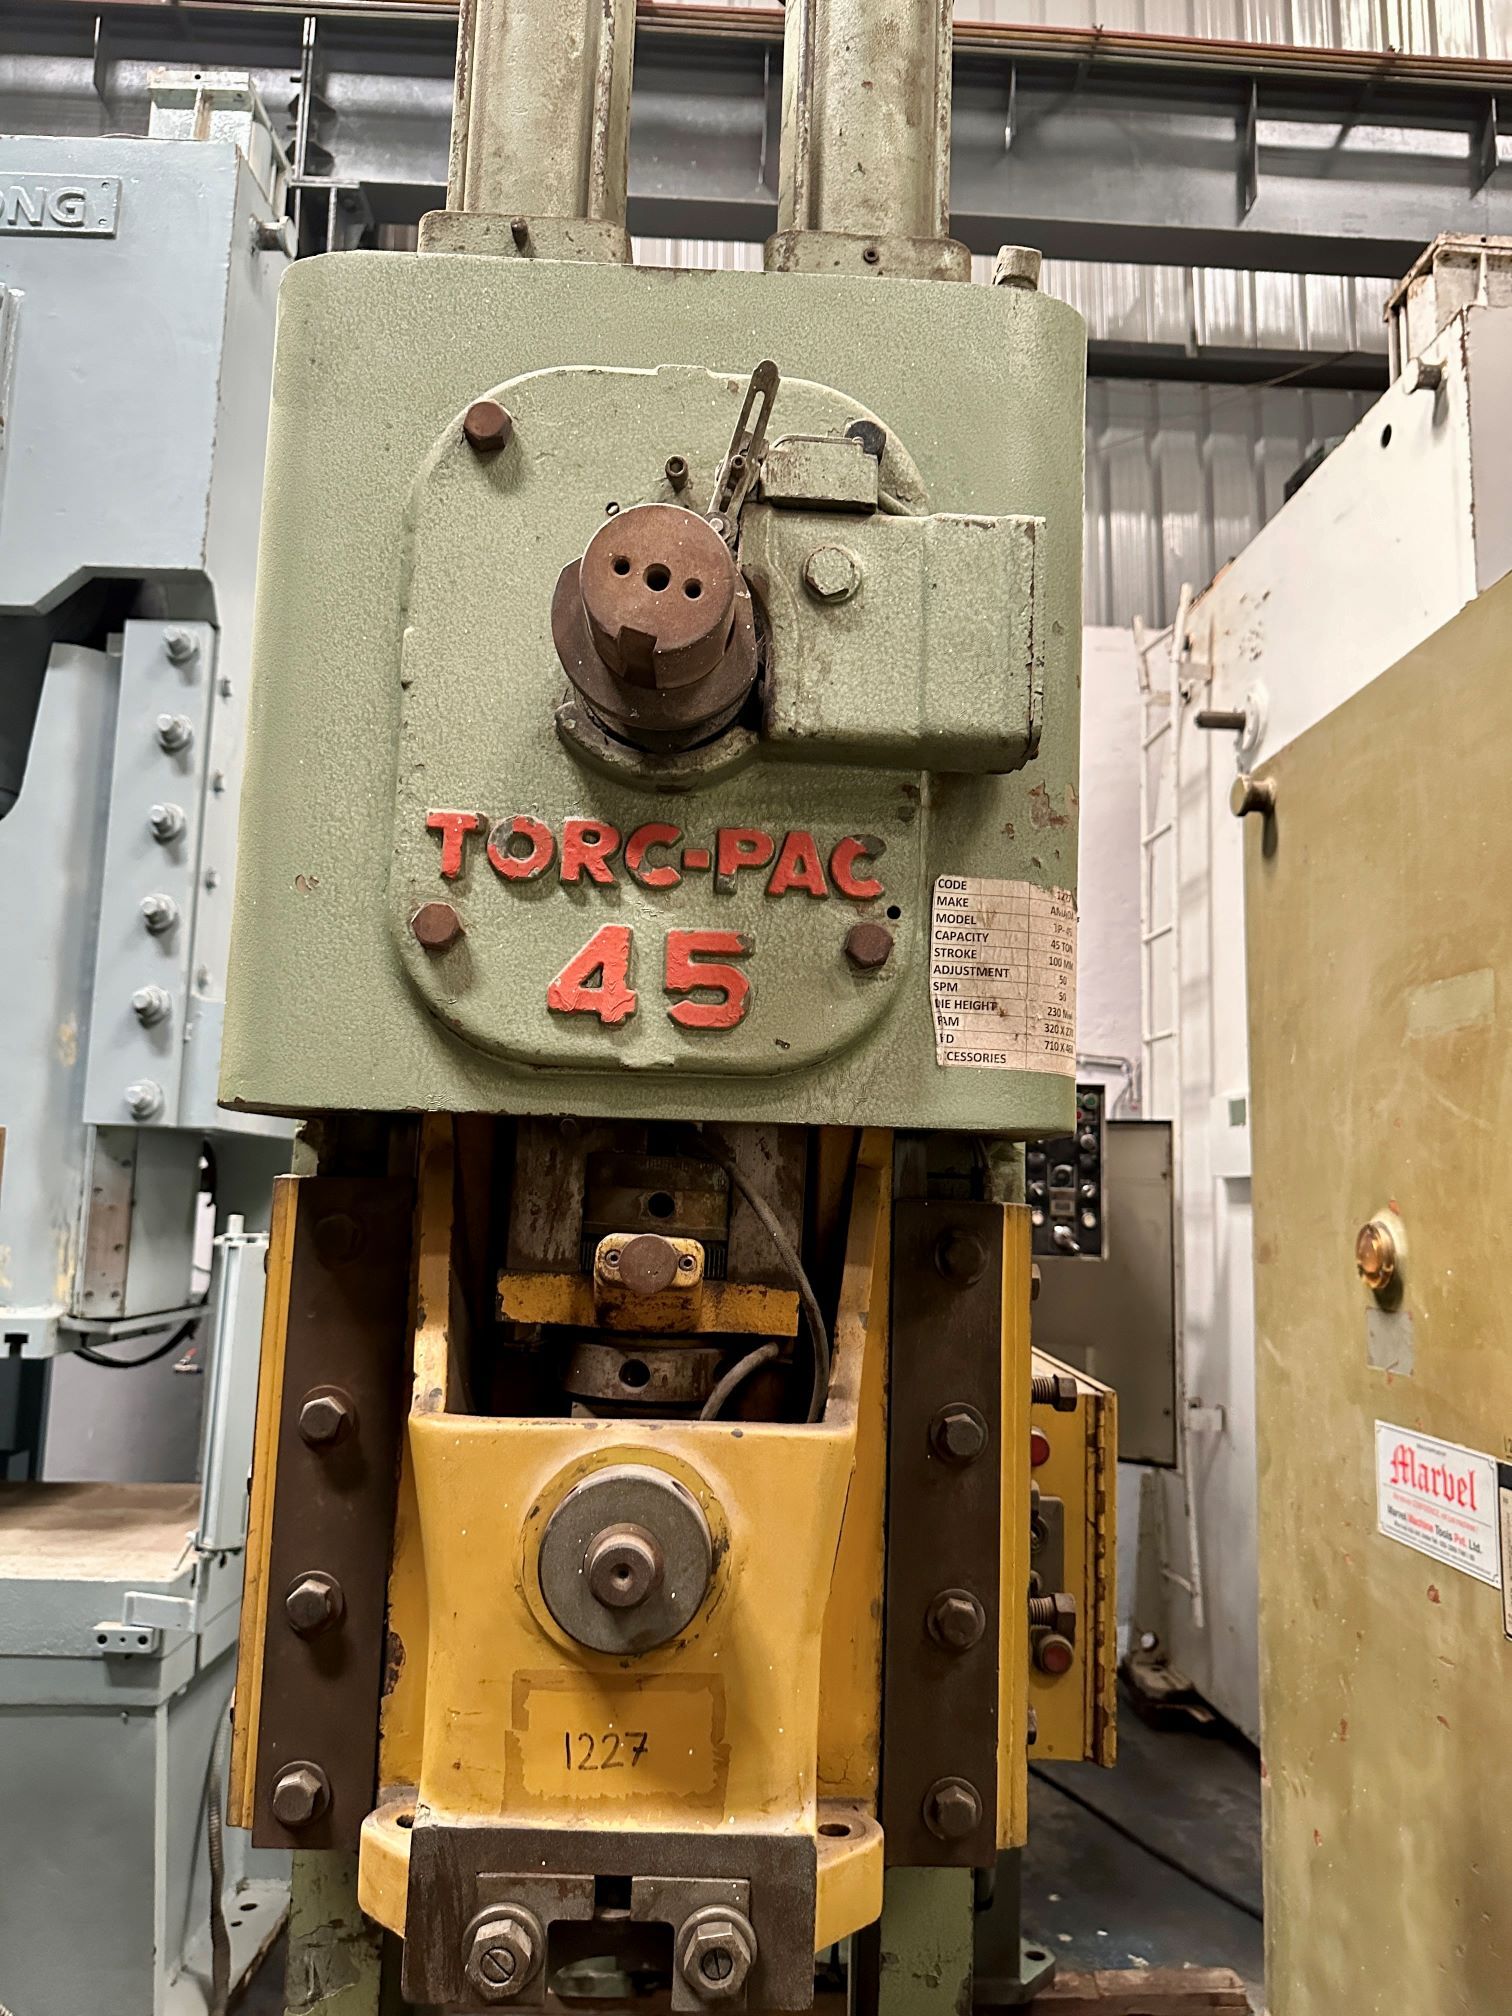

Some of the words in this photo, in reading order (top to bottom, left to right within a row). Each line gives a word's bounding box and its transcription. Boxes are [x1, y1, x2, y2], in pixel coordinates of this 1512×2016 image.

[0, 186, 87, 227] NG
[426, 809, 887, 900] TORC-PAC
[938, 879, 967, 890] CODE
[936, 896, 969, 908] MAKE
[935, 913, 977, 925] MODEL
[935, 930, 989, 942] CAPACITY
[1051, 940, 1061, 950] 45
[1061, 942, 1073, 954] TON
[934, 947, 977, 959] STROKE
[1049, 956, 1062, 967] 100
[547, 923, 755, 1031] 45
[933, 965, 1010, 978] ADJUSTMENT
[1059, 975, 1067, 985] 50
[933, 981, 958, 992] SPM
[1059, 992, 1067, 1002] 50
[954, 999, 997, 1011] HEIGHT
[1047, 1006, 1061, 1018] 230
[1044, 1023, 1059, 1034] 320
[1044, 1040, 1059, 1052] 710
[944, 1051, 1007, 1064] CESSORIES
[1390, 1444, 1477, 1511] Marvel
[565, 1731, 649, 1771] 1227
